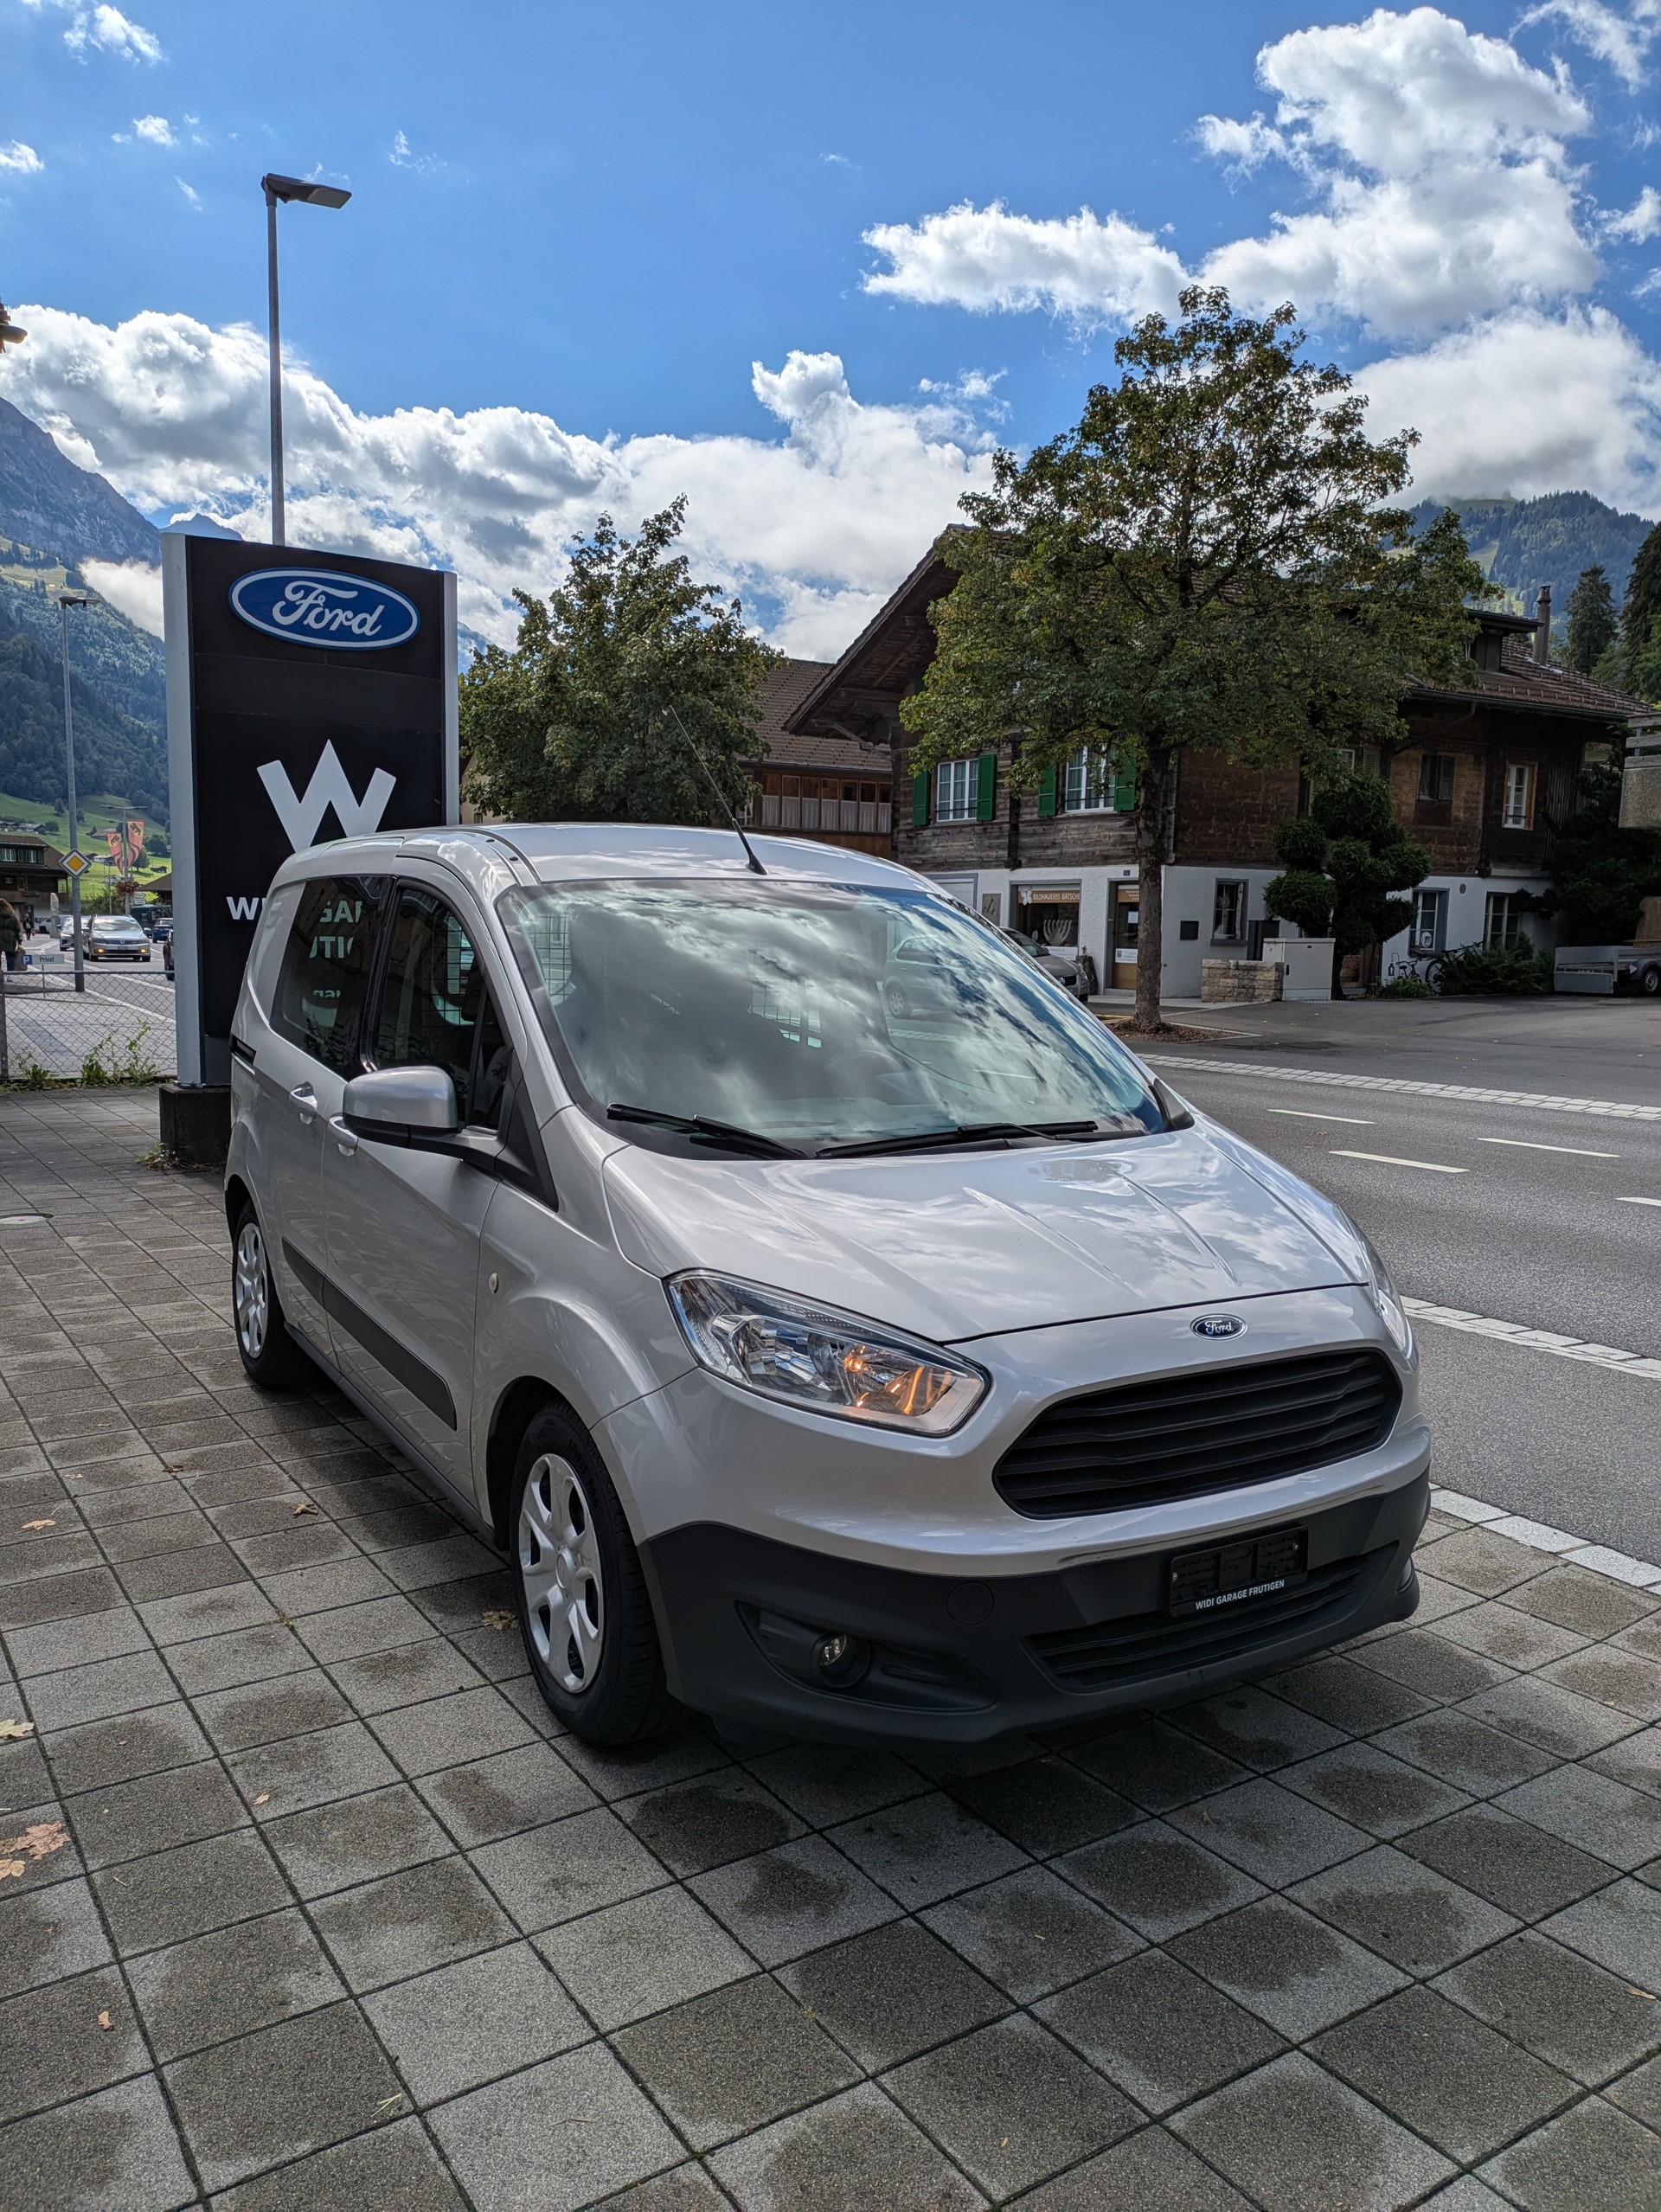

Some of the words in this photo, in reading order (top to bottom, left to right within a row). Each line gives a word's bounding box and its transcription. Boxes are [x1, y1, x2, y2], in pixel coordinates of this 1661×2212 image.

[272, 580, 385, 636] Ford
[256, 739, 397, 853] W
[1204, 1319, 1235, 1335] Ford
[1195, 1598, 1215, 1610] WIDI
[1215, 1589, 1247, 1605] GARAGE
[1248, 1579, 1285, 1597] FRUTIGEN
